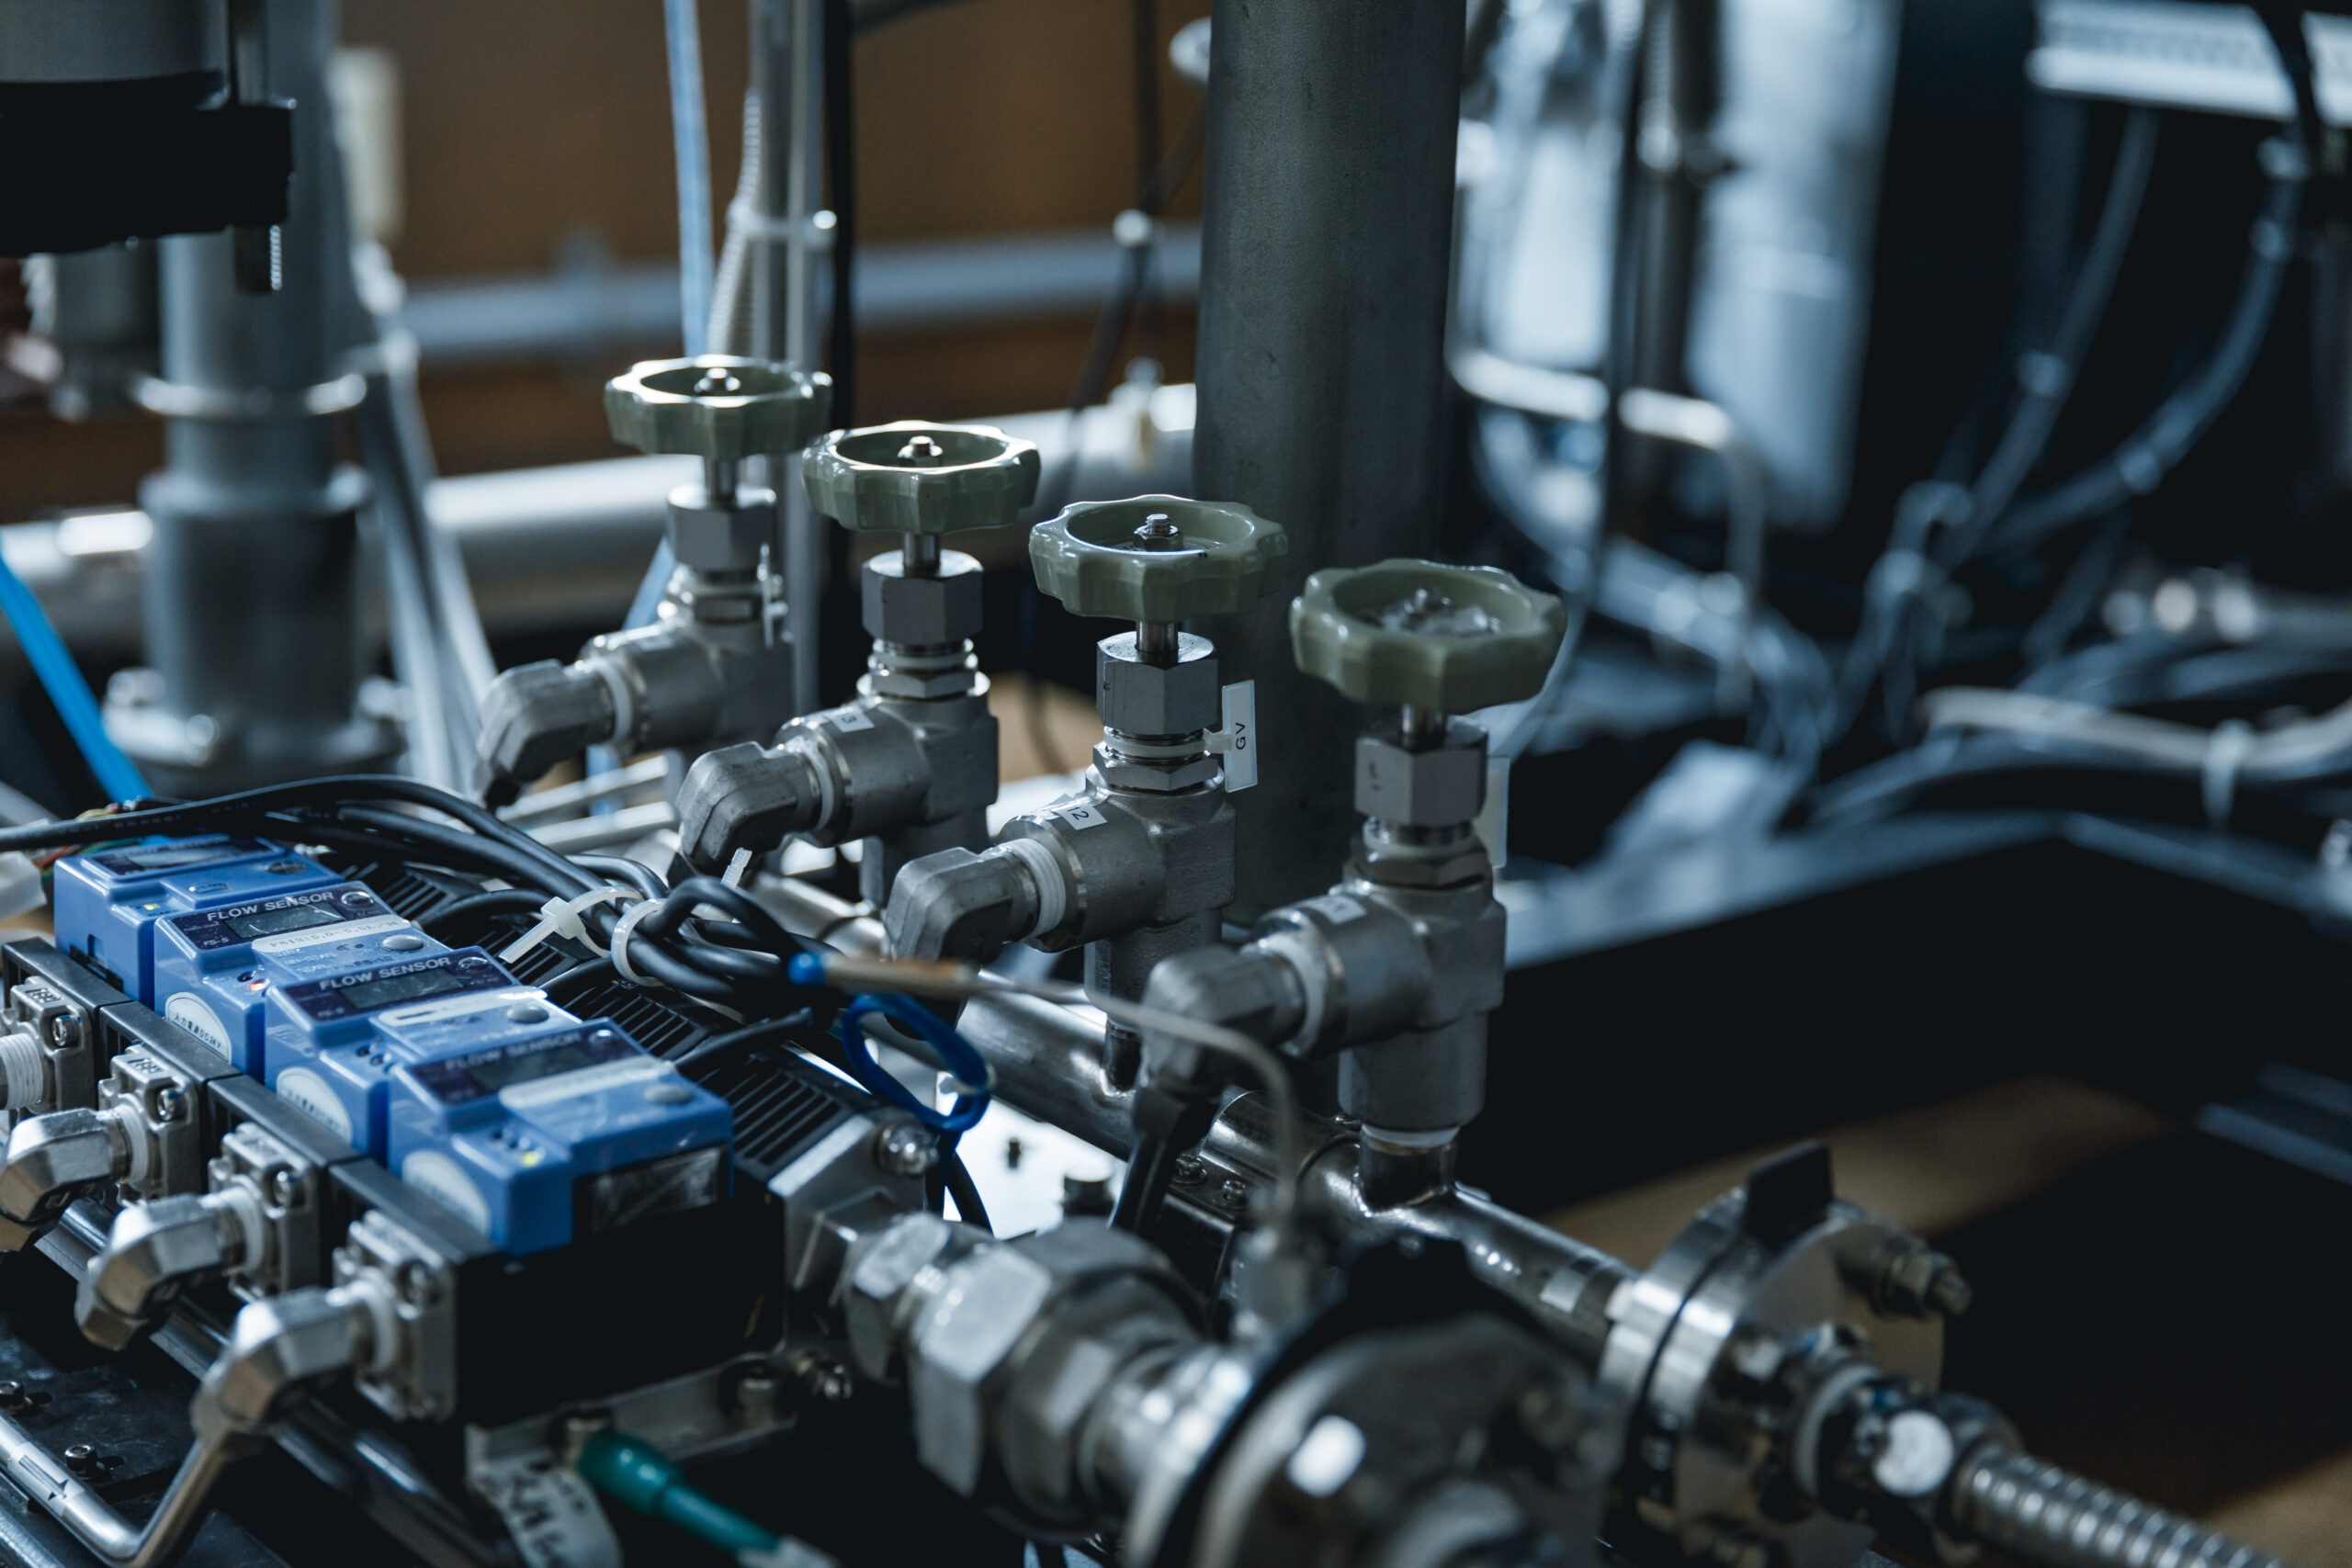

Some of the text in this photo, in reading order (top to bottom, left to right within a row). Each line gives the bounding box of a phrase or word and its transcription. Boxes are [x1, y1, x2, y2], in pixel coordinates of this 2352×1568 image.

[1235, 722, 1247, 750] GV
[1067, 807, 1090, 820] 12
[207, 891, 334, 922] FLOW SENSOR
[319, 956, 452, 991] FLOW SENSOR
